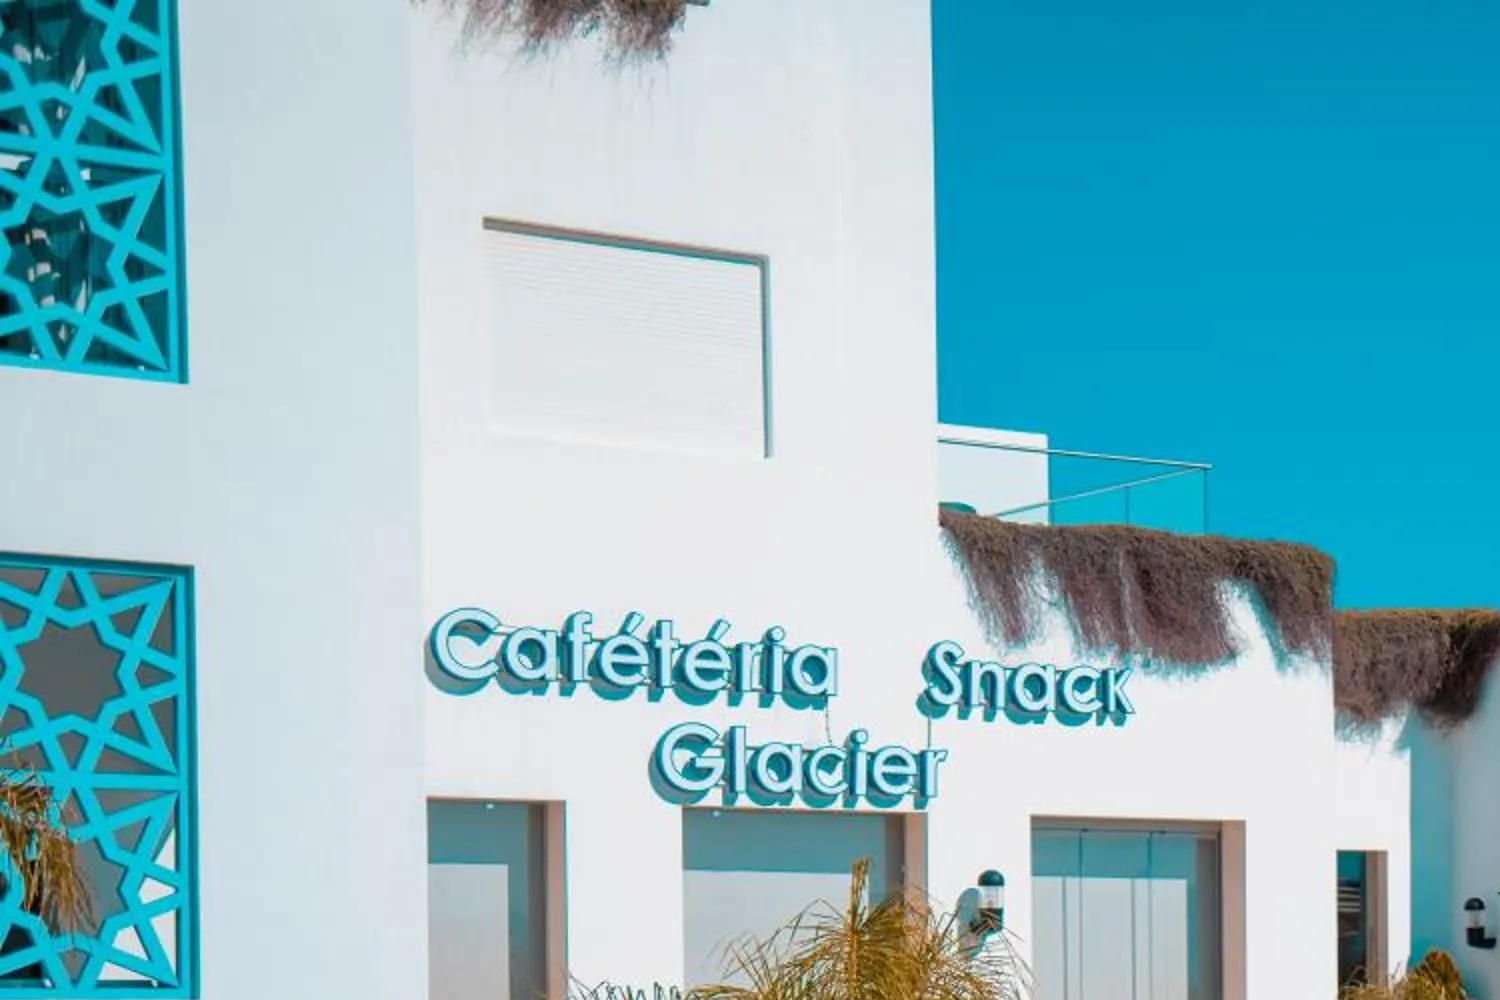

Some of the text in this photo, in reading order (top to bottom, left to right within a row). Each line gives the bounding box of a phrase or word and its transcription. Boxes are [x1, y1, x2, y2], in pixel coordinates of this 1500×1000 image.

[428, 606, 1136, 714] Cafétéria Snack
[654, 721, 949, 799] Glacier
